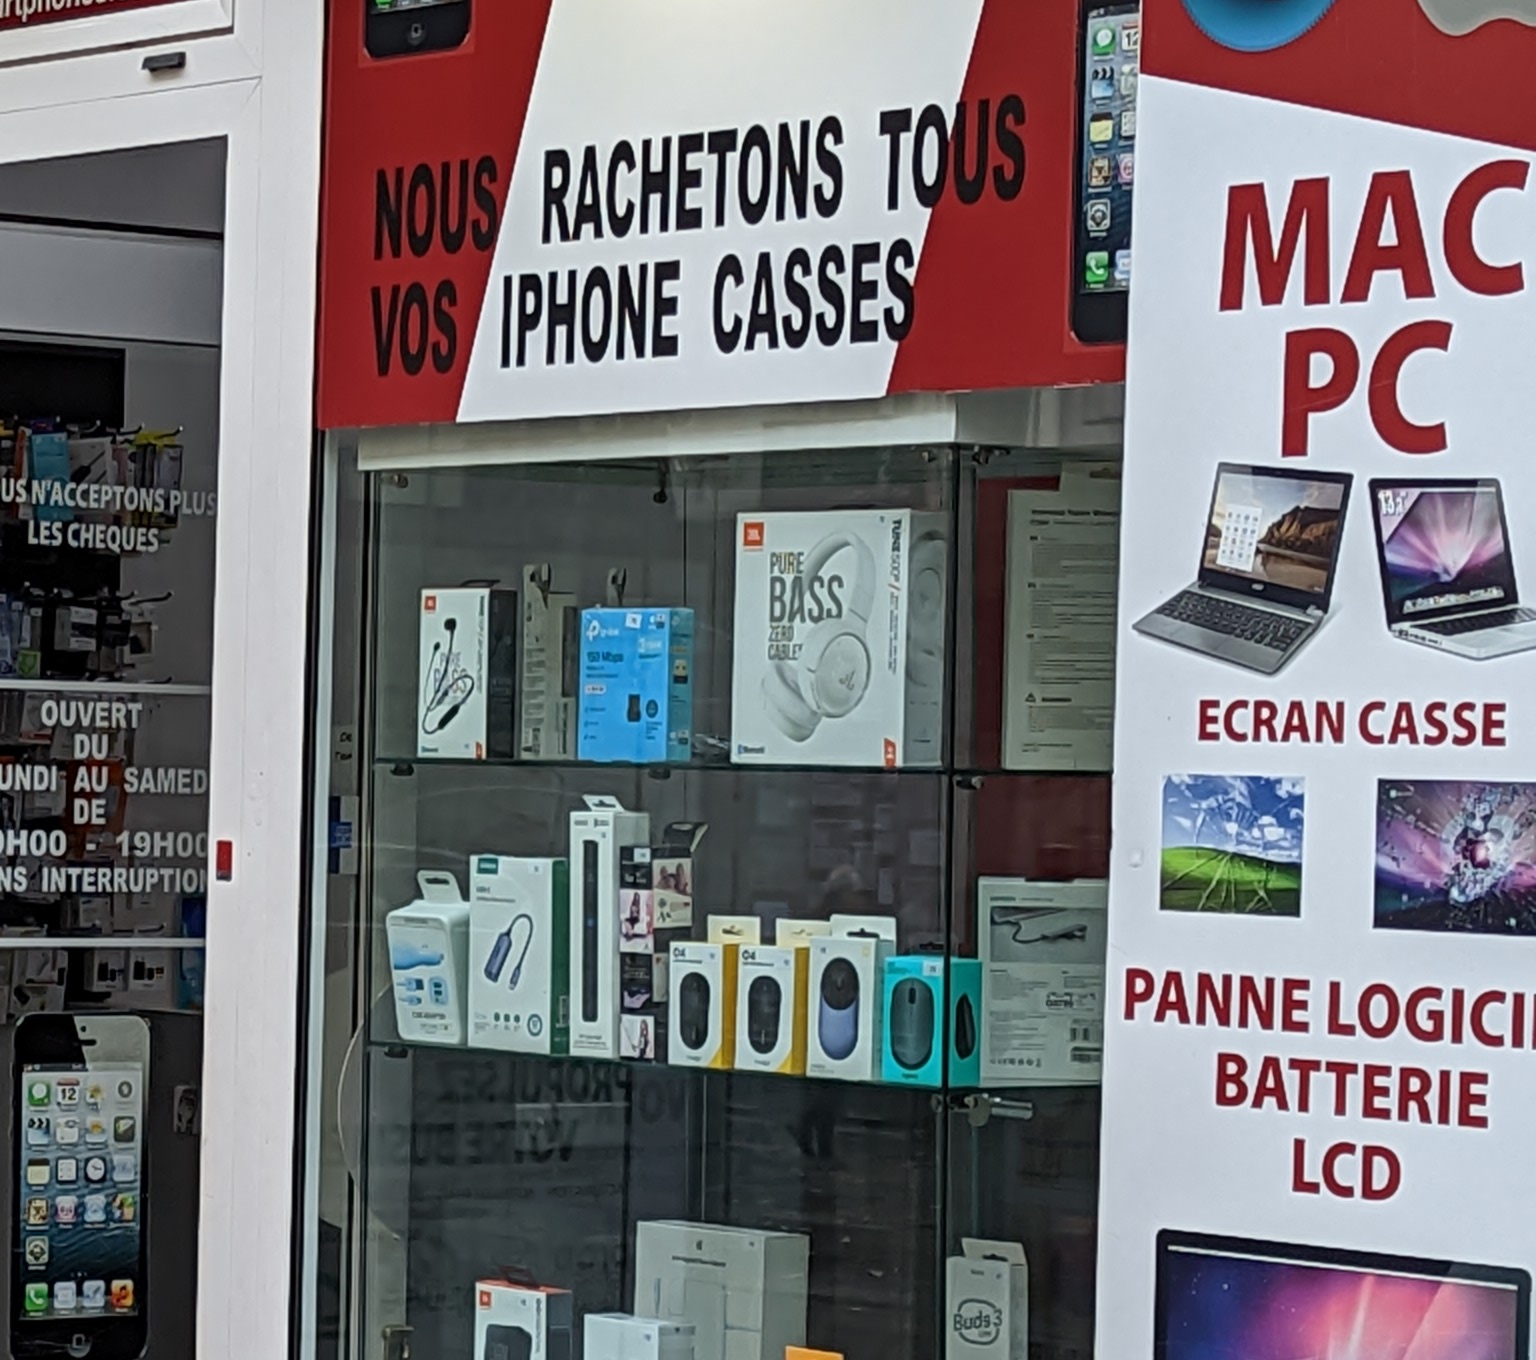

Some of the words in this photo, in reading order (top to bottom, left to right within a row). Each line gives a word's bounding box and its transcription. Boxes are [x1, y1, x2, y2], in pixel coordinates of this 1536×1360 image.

[374, 155, 498, 260] NOUS
[541, 116, 844, 246] RACHETONS
[880, 94, 1026, 211] TOUS
[1219, 160, 1531, 312] MAC
[371, 278, 457, 377] VOS
[501, 261, 681, 370] IPHONE
[714, 238, 915, 354] CASSES
[1281, 320, 1453, 458] PC
[31, 479, 164, 513] N'ACCEPTONS
[170, 490, 218, 516] PLUS
[28, 520, 62, 546] LES
[67, 523, 159, 553] CHEQUES
[770, 552, 804, 574] PURE
[770, 574, 844, 624] BASS
[41, 700, 142, 728] OUVERT
[1198, 700, 1345, 744] ECRAN
[1359, 701, 1506, 747] CASSE
[74, 734, 109, 761] DU
[74, 766, 108, 792] AU
[73, 798, 106, 825] DE
[1124, 968, 1310, 1034] PANNE
[1215, 1053, 1489, 1129] BATTERIE
[1292, 1138, 1401, 1201] LCD
[953, 1309, 991, 1332] Buds
[993, 1308, 1003, 1327] 3
